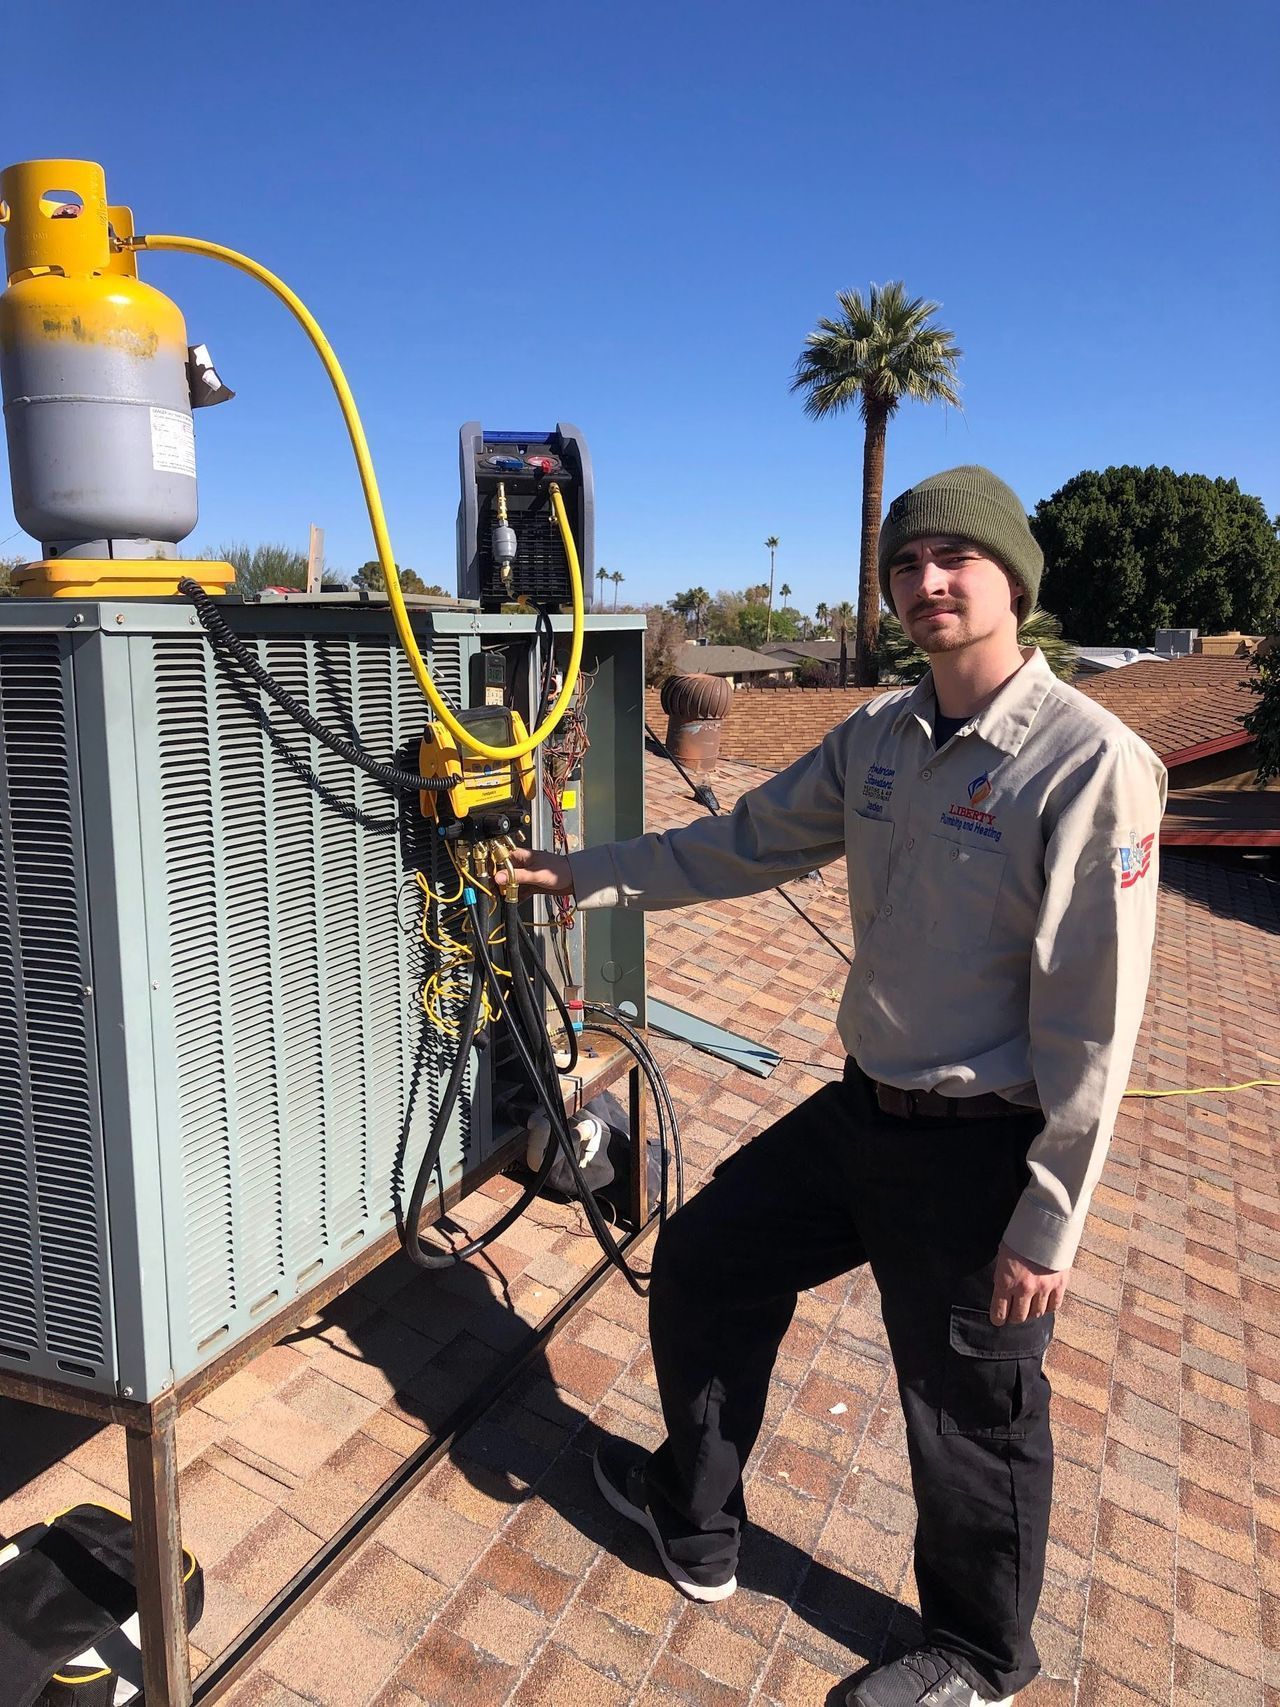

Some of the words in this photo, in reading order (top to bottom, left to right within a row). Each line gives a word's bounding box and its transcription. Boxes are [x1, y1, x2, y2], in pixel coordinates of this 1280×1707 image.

[949, 804, 996, 825] LIBERTY
[962, 821, 975, 832] and
[974, 822, 1003, 843] Heating
